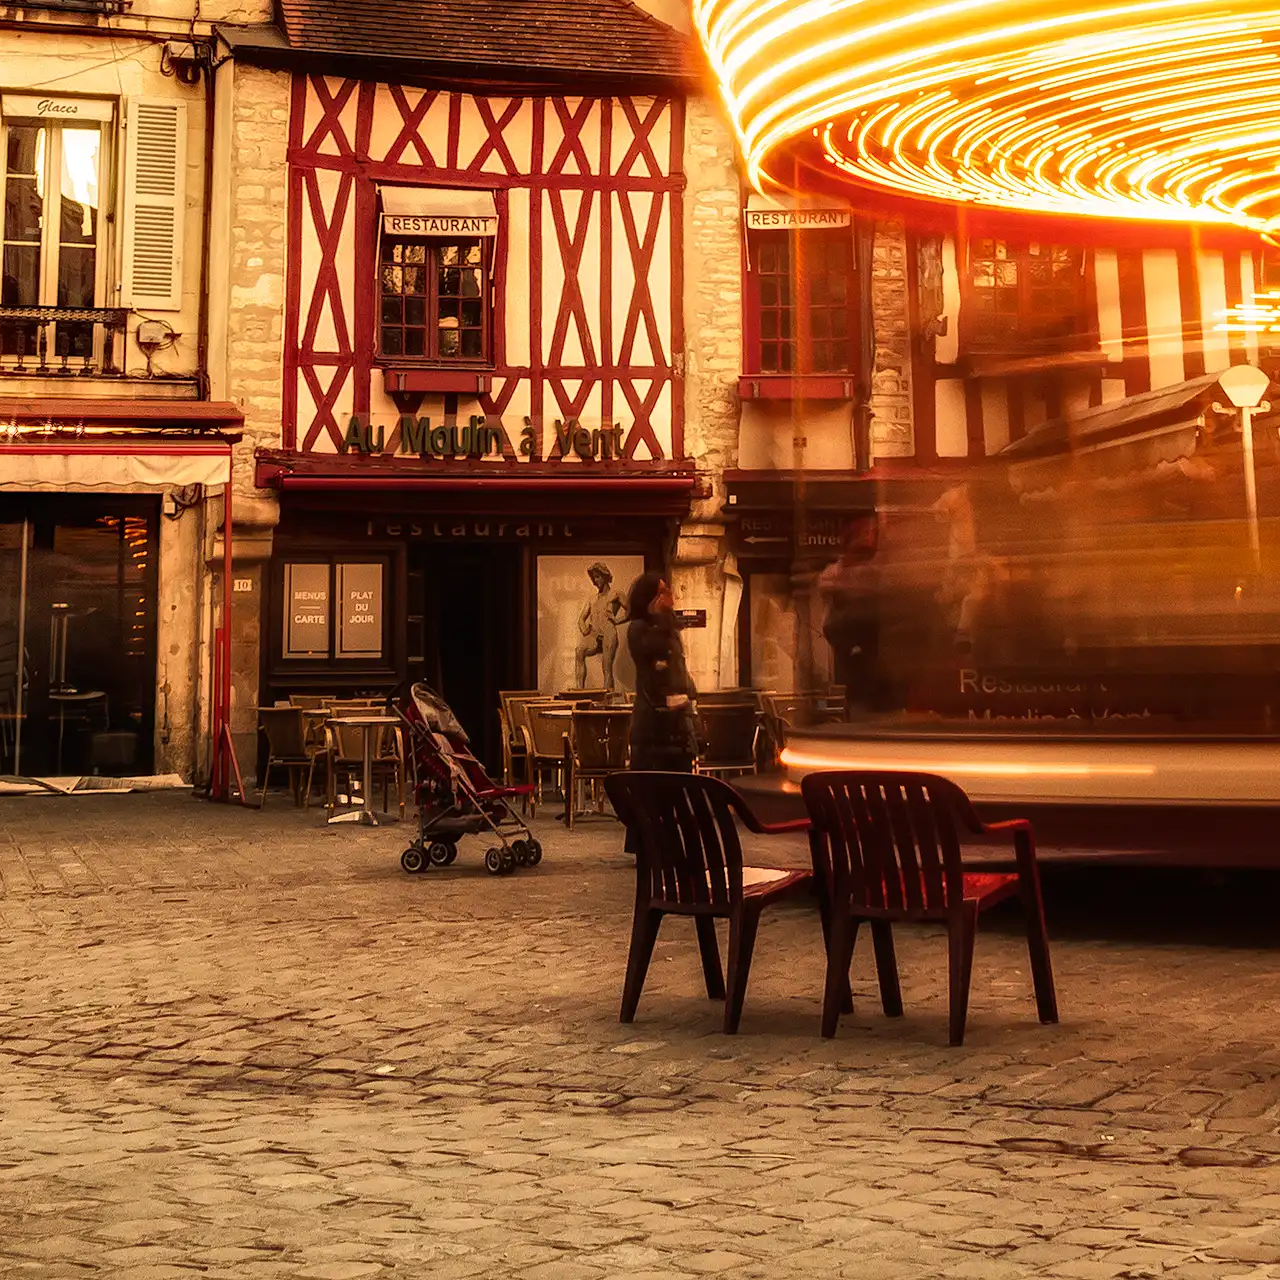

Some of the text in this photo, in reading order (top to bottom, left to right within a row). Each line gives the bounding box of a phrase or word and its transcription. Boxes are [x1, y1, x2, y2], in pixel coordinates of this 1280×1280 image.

[37, 99, 78, 115] Glaces
[752, 212, 845, 226] RESTAURANT
[392, 218, 490, 232] RESTAURANT
[341, 415, 626, 458] Au Moulin à Vent
[237, 582, 249, 590] 10
[294, 591, 326, 600] MENUS
[350, 591, 373, 600] PLAT
[355, 603, 368, 612] DU
[294, 615, 325, 624] CARTE
[349, 615, 374, 624] JOUR
